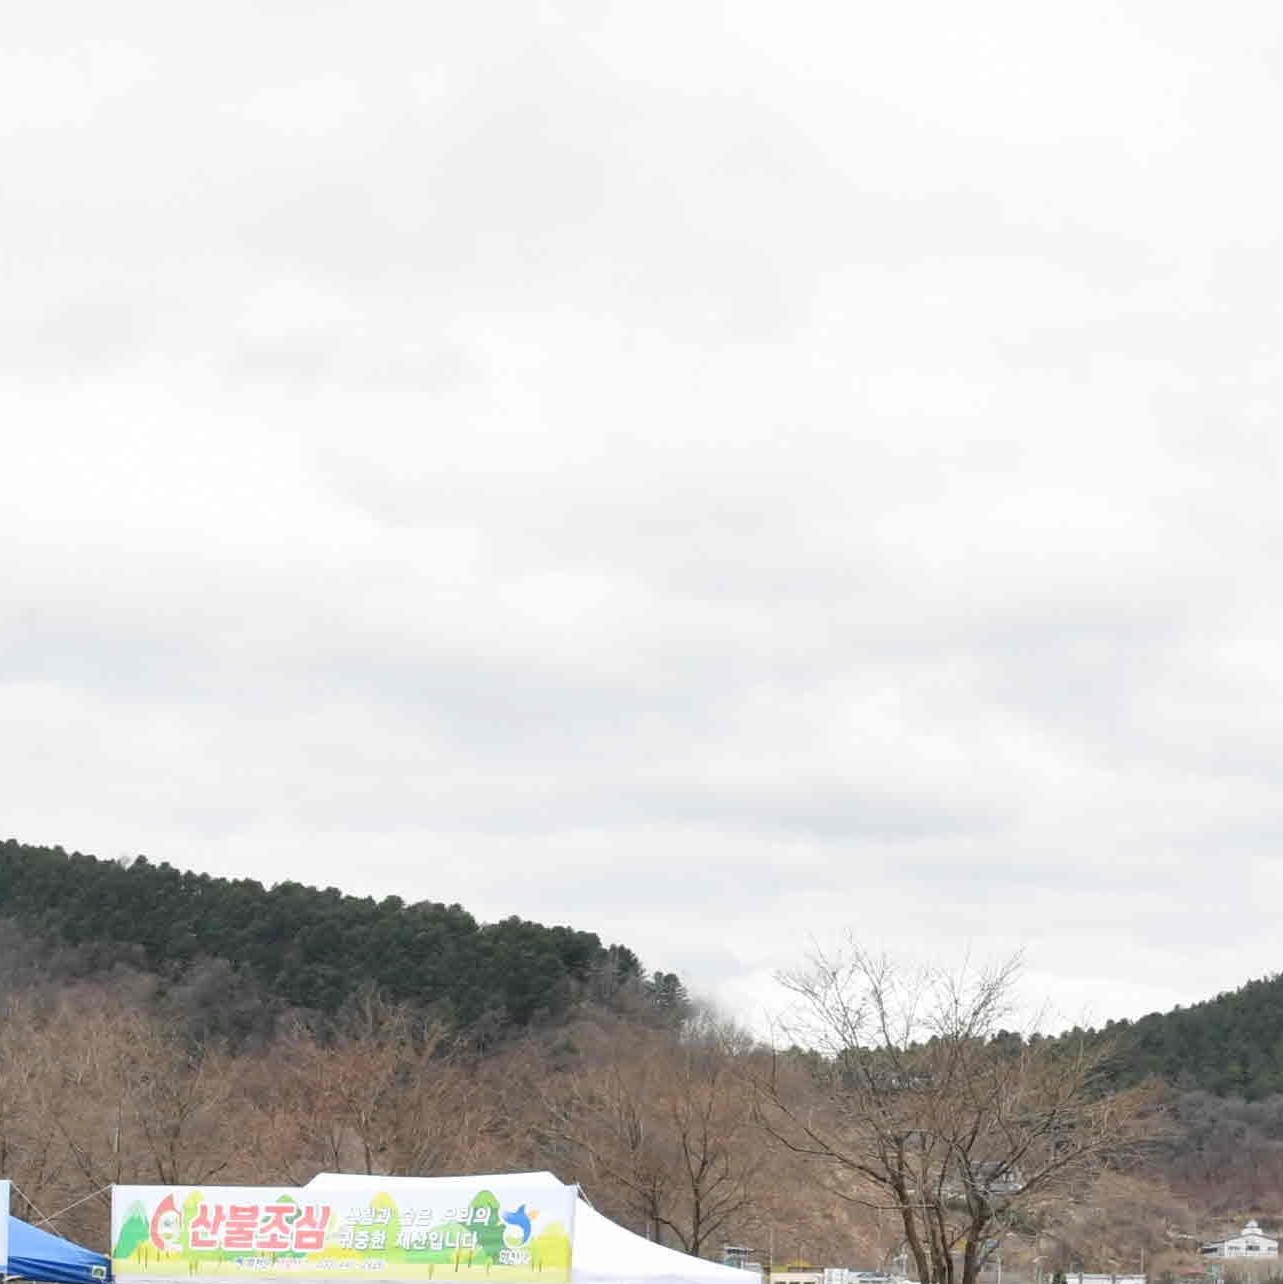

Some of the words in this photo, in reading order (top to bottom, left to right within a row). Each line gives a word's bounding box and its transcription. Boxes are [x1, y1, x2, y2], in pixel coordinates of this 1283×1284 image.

[189, 1203, 332, 1250] 산불조심
[444, 1207, 491, 1226] 우리의
[340, 1230, 387, 1250] 귀중한
